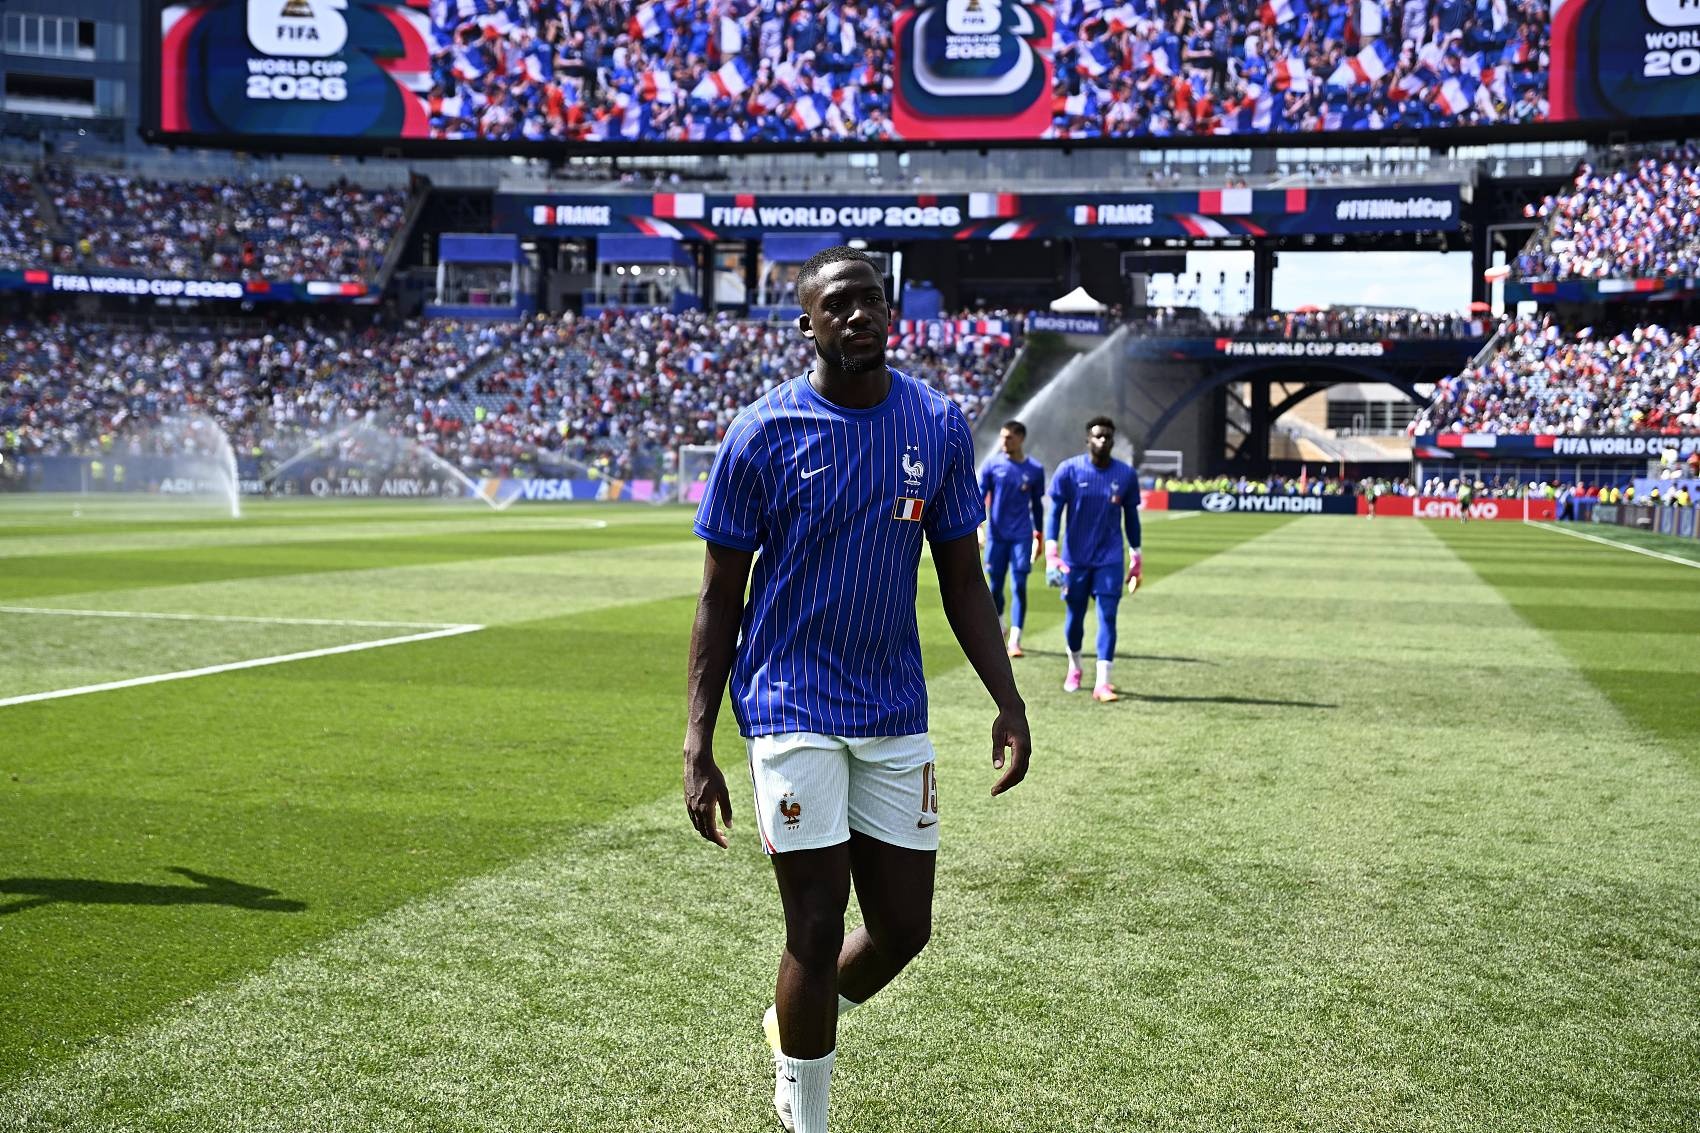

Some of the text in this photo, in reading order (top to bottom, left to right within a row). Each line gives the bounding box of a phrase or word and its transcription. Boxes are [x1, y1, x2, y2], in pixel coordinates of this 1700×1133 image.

[277, 26, 319, 40] FIFA
[946, 43, 1001, 60] 2026
[246, 59, 348, 77] WORLD CUP
[1643, 49, 1700, 77] 20
[246, 74, 348, 101] 2026
[556, 205, 611, 225] FRANCE
[711, 206, 961, 227] FIFA WORLD CUP 2026
[1097, 204, 1153, 225] FRANCE
[1336, 197, 1452, 220] #FIFAWorldCup
[53, 274, 243, 298] FIFA WORLD CUP 2026
[1034, 317, 1099, 333] BOSTON
[1225, 342, 1384, 357] FIFA WORLD CUP 2026
[1553, 438, 1589, 455] FIFA
[1588, 438, 1645, 455] WORLD
[310, 477, 369, 497] QTA
[523, 479, 573, 500] VISA
[1238, 496, 1323, 513] HYUNDAI
[1412, 497, 1499, 518] Lenvo
